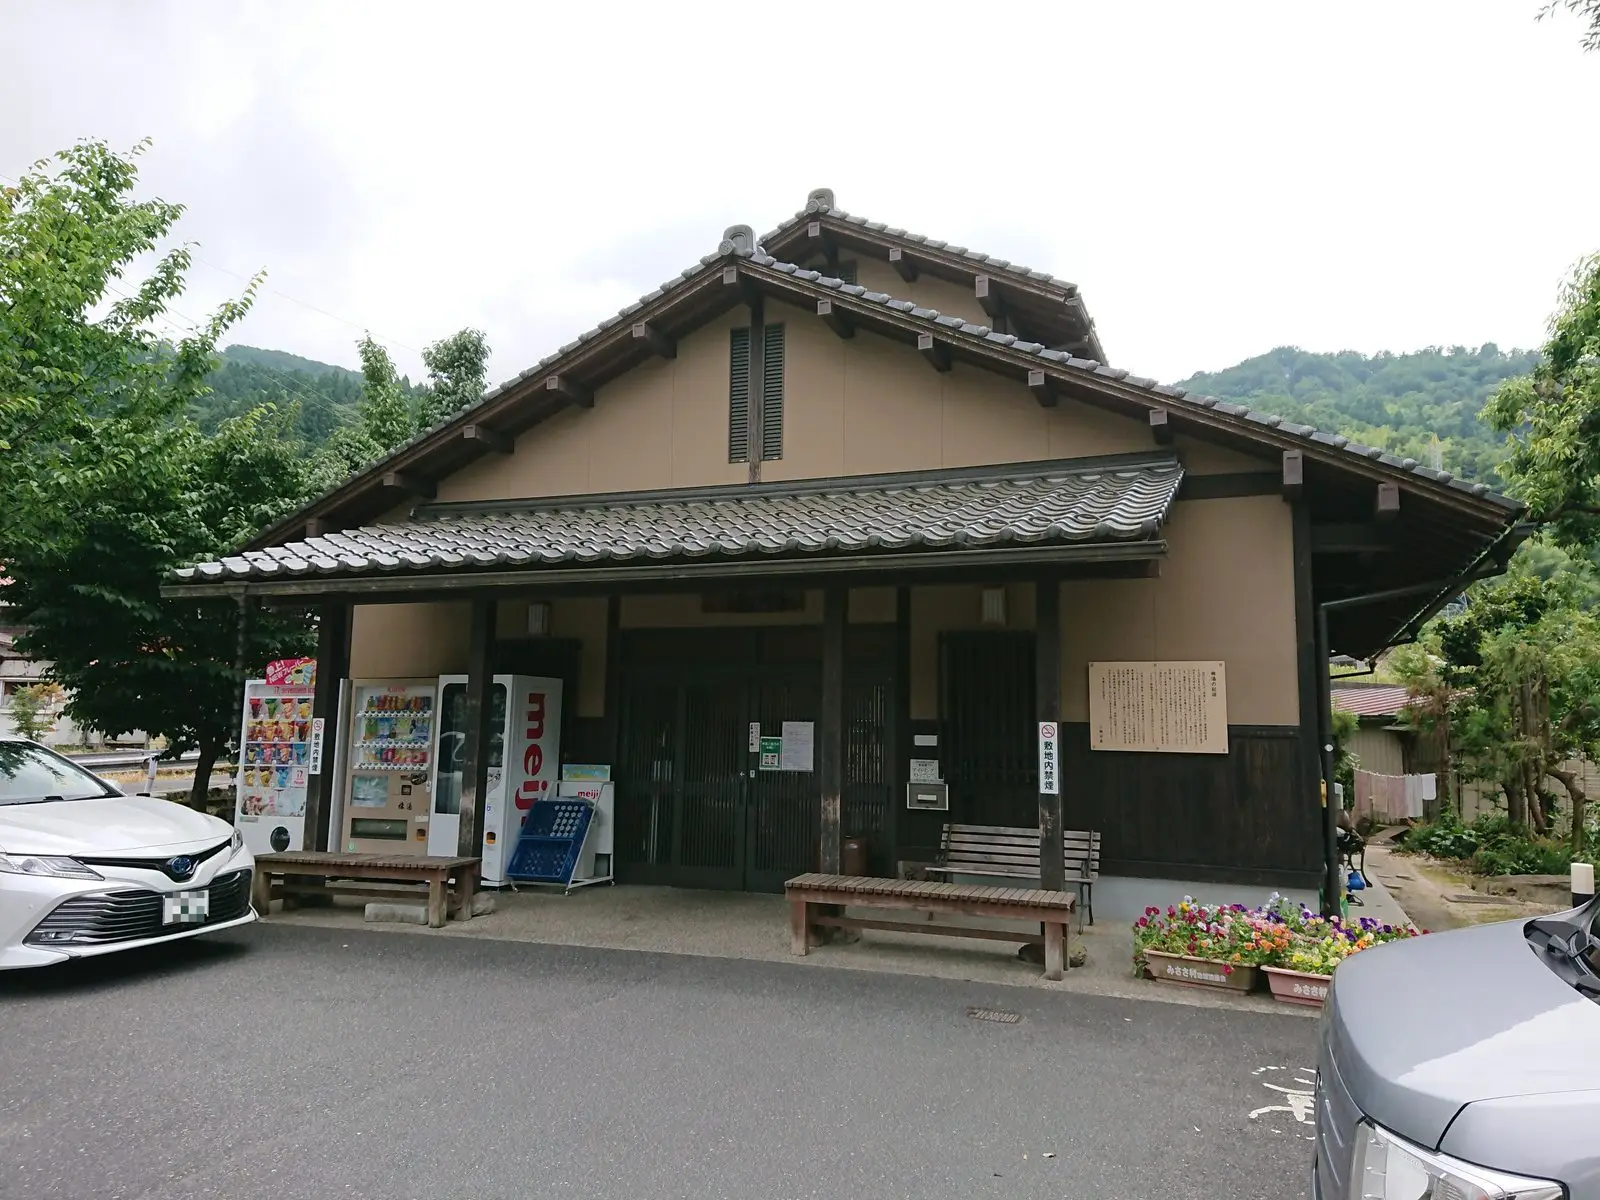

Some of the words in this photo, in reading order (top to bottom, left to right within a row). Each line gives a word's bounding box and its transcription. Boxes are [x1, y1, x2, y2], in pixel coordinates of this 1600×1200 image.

[312, 733, 321, 772] 敷地内禁煙
[1043, 741, 1054, 790] 敷地内禁煙
[577, 789, 599, 800] meiji
